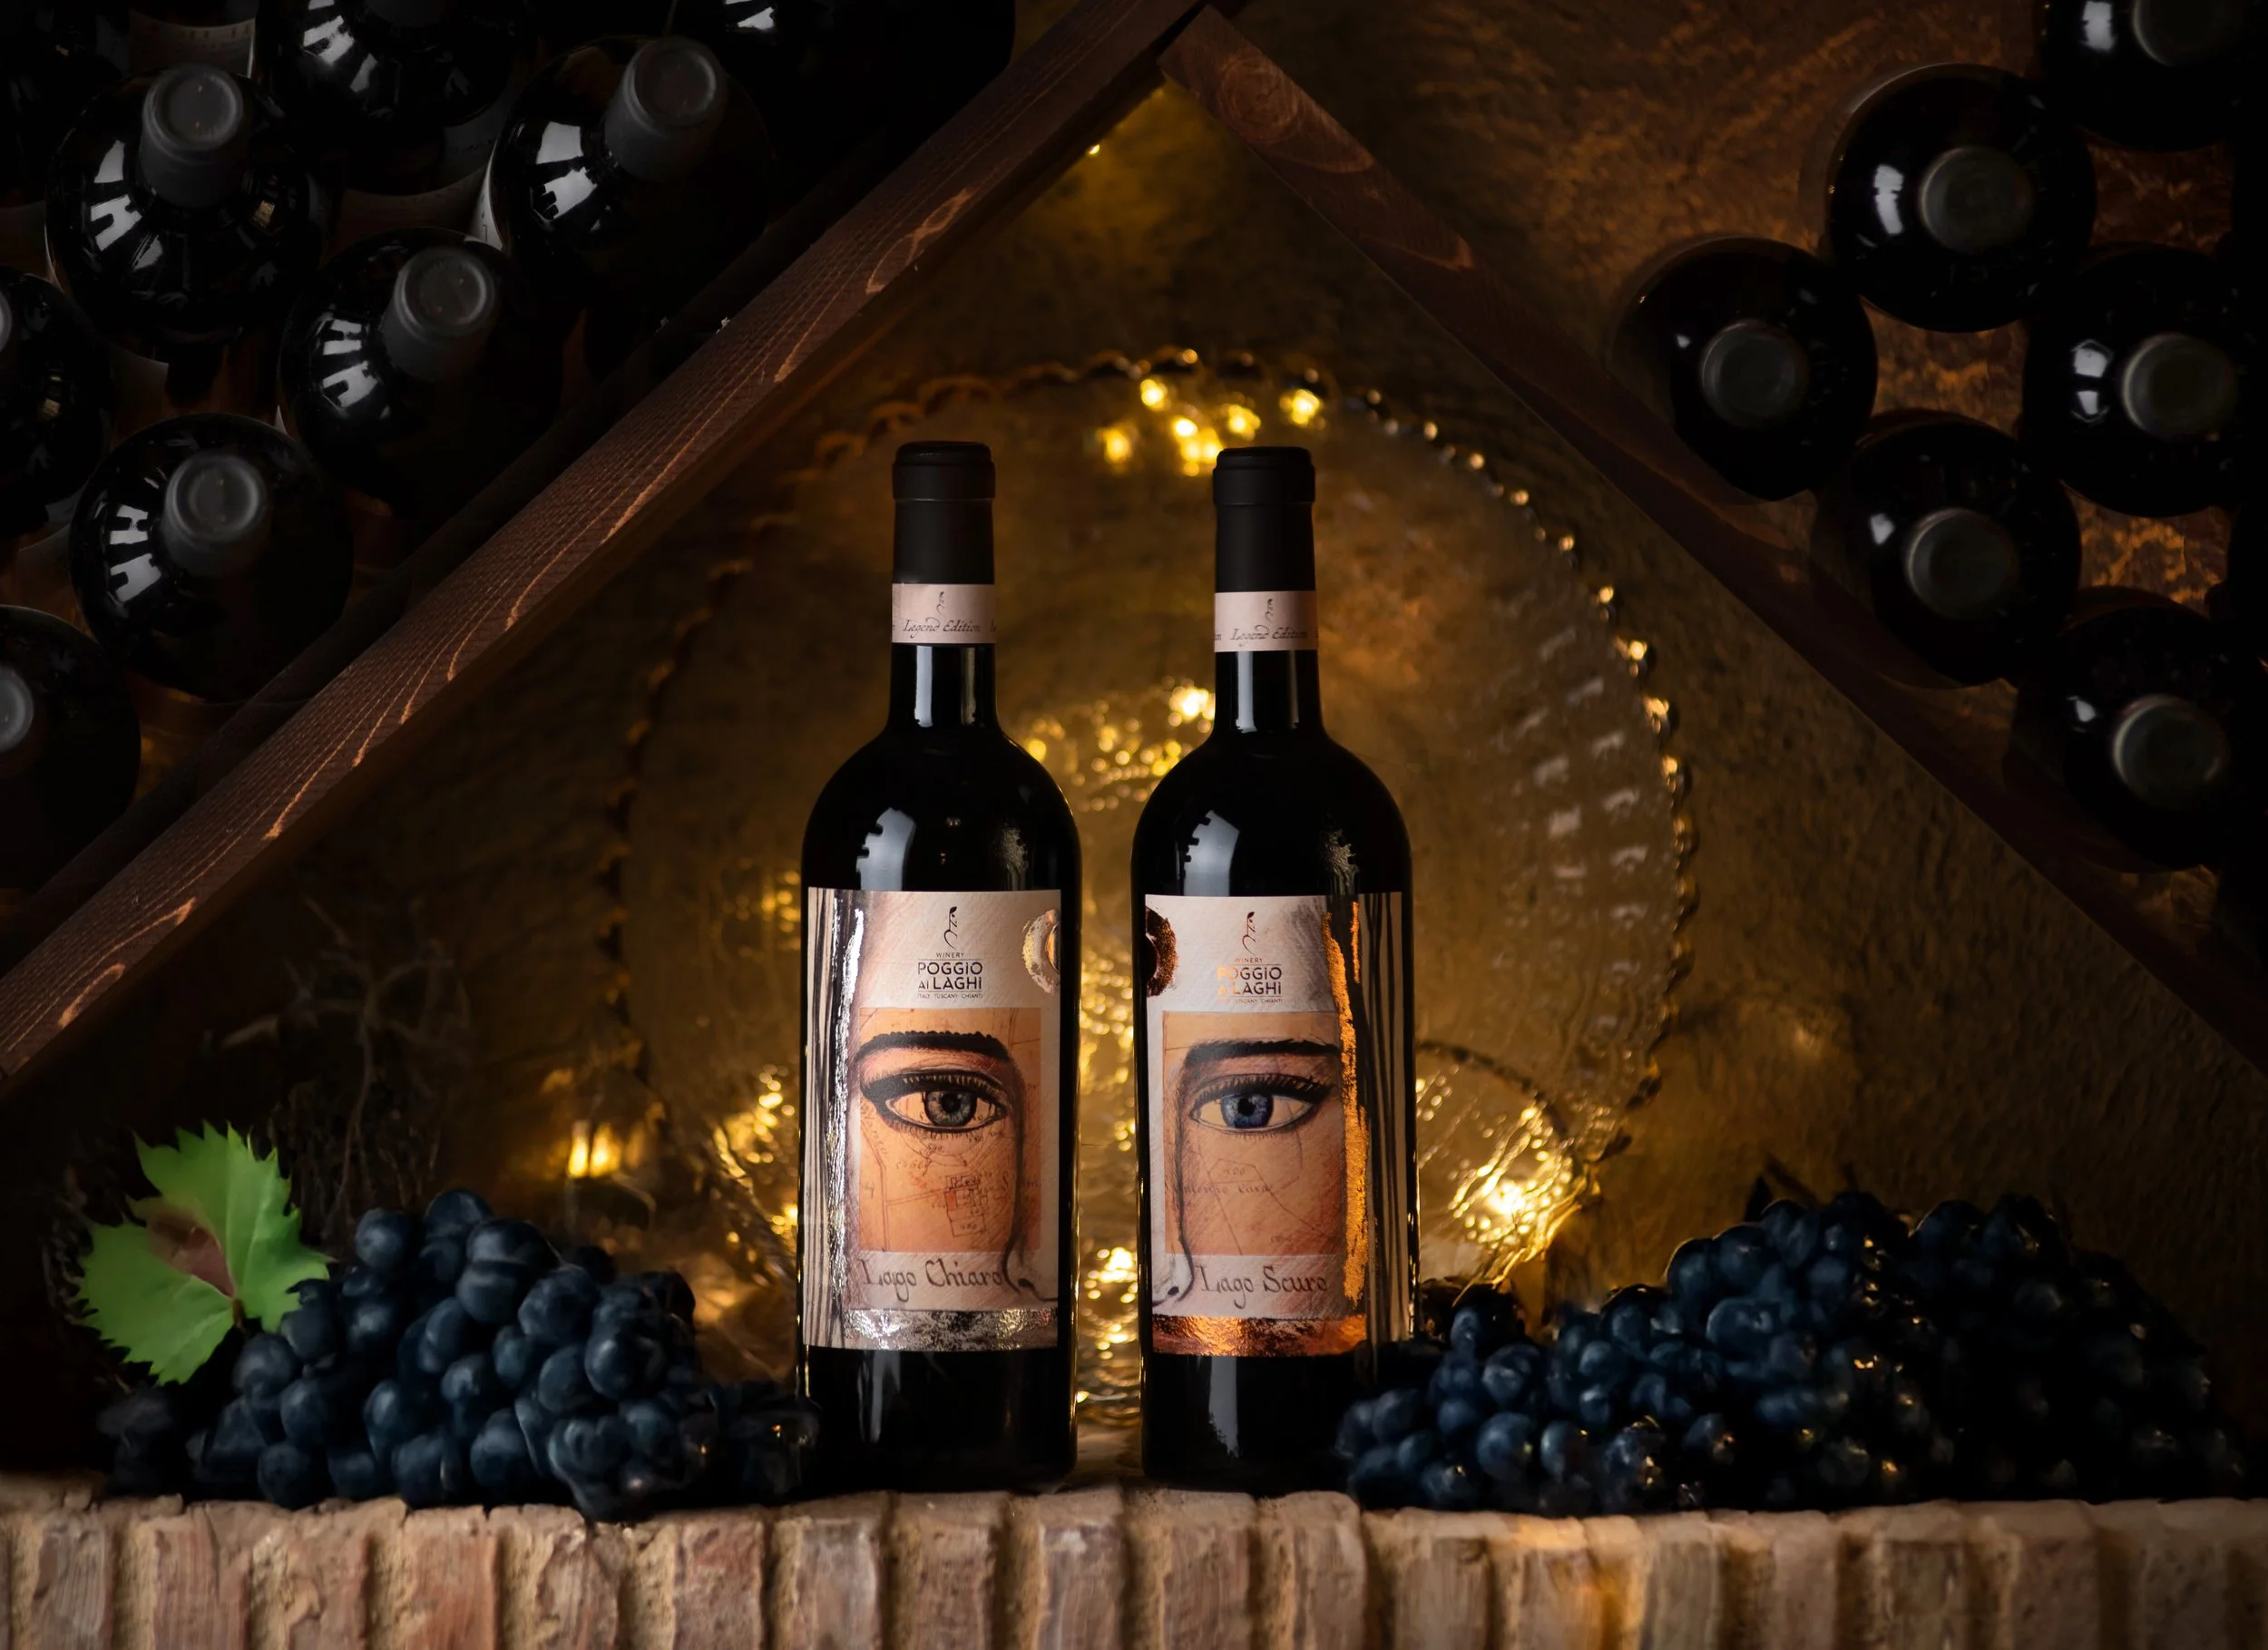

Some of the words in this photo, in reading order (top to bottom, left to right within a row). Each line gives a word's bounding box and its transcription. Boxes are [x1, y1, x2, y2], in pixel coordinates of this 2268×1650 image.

[903, 617, 940, 639] Legend
[943, 620, 981, 632] Edition
[918, 962, 982, 975] POGGIO
[1217, 965, 1282, 980] POGGIO
[934, 977, 982, 990] LAGHI
[1233, 981, 1282, 994] LAGHI
[925, 1258, 1002, 1287] Chiaro
[1196, 1264, 1254, 1309] Lago
[1263, 1265, 1327, 1293] Scuro
